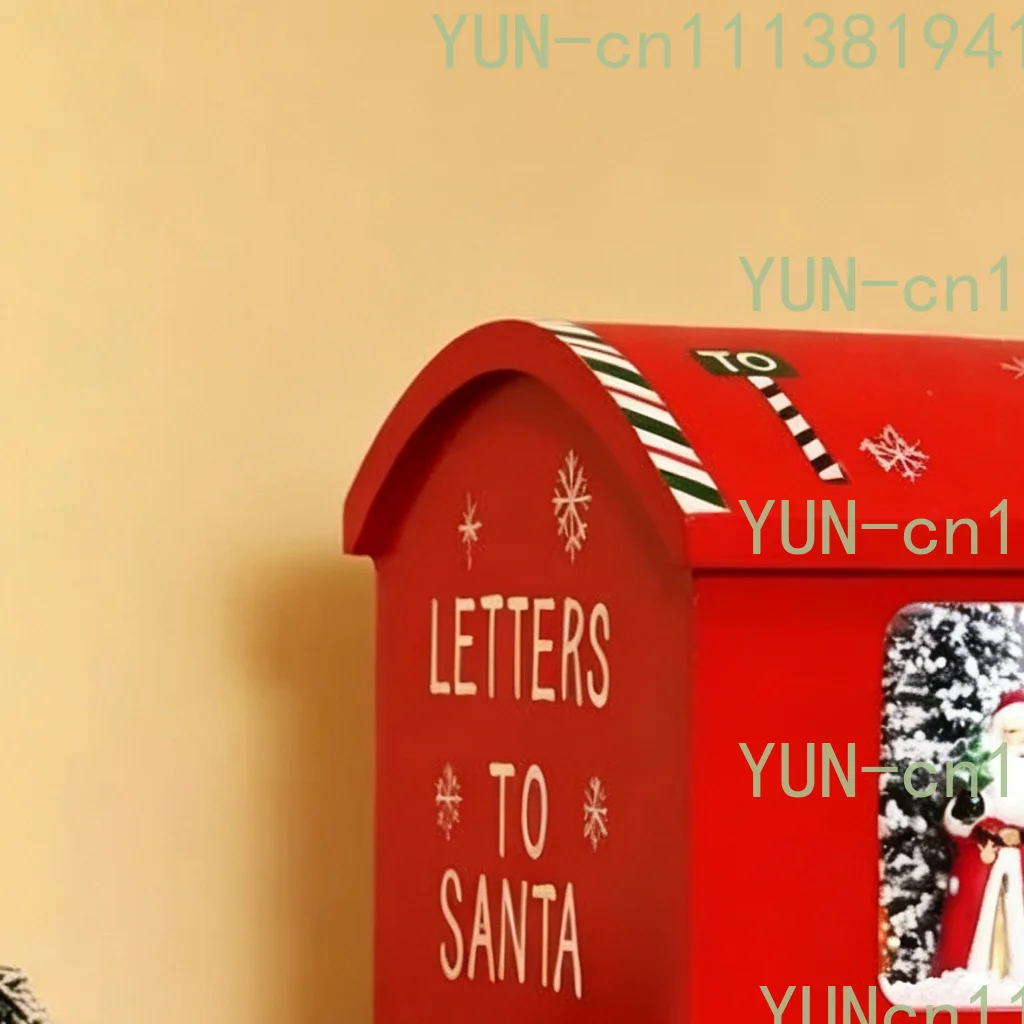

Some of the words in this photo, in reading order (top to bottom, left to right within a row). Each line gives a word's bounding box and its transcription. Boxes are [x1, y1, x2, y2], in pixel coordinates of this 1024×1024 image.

[696, 350, 778, 373] TO
[429, 594, 610, 709] LETTERS
[488, 762, 548, 860] TO
[439, 868, 582, 1000] SANTA
